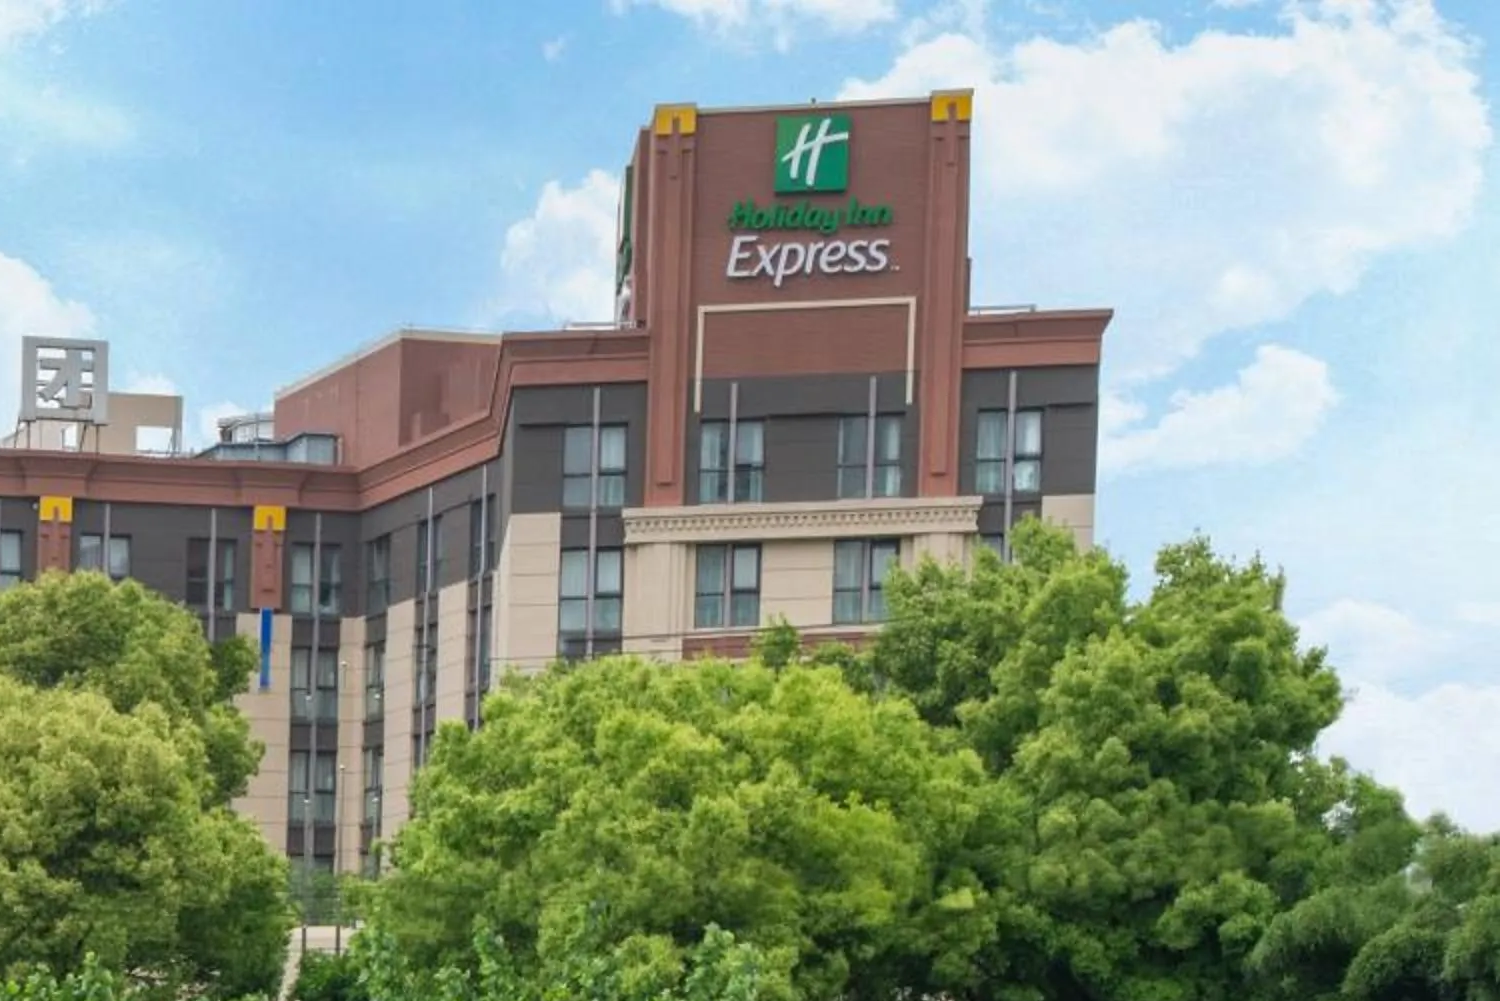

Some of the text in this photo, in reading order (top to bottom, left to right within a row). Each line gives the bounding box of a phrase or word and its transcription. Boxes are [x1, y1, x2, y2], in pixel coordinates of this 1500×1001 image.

[729, 196, 893, 234] Holiday Inn
[727, 235, 890, 288] Express
